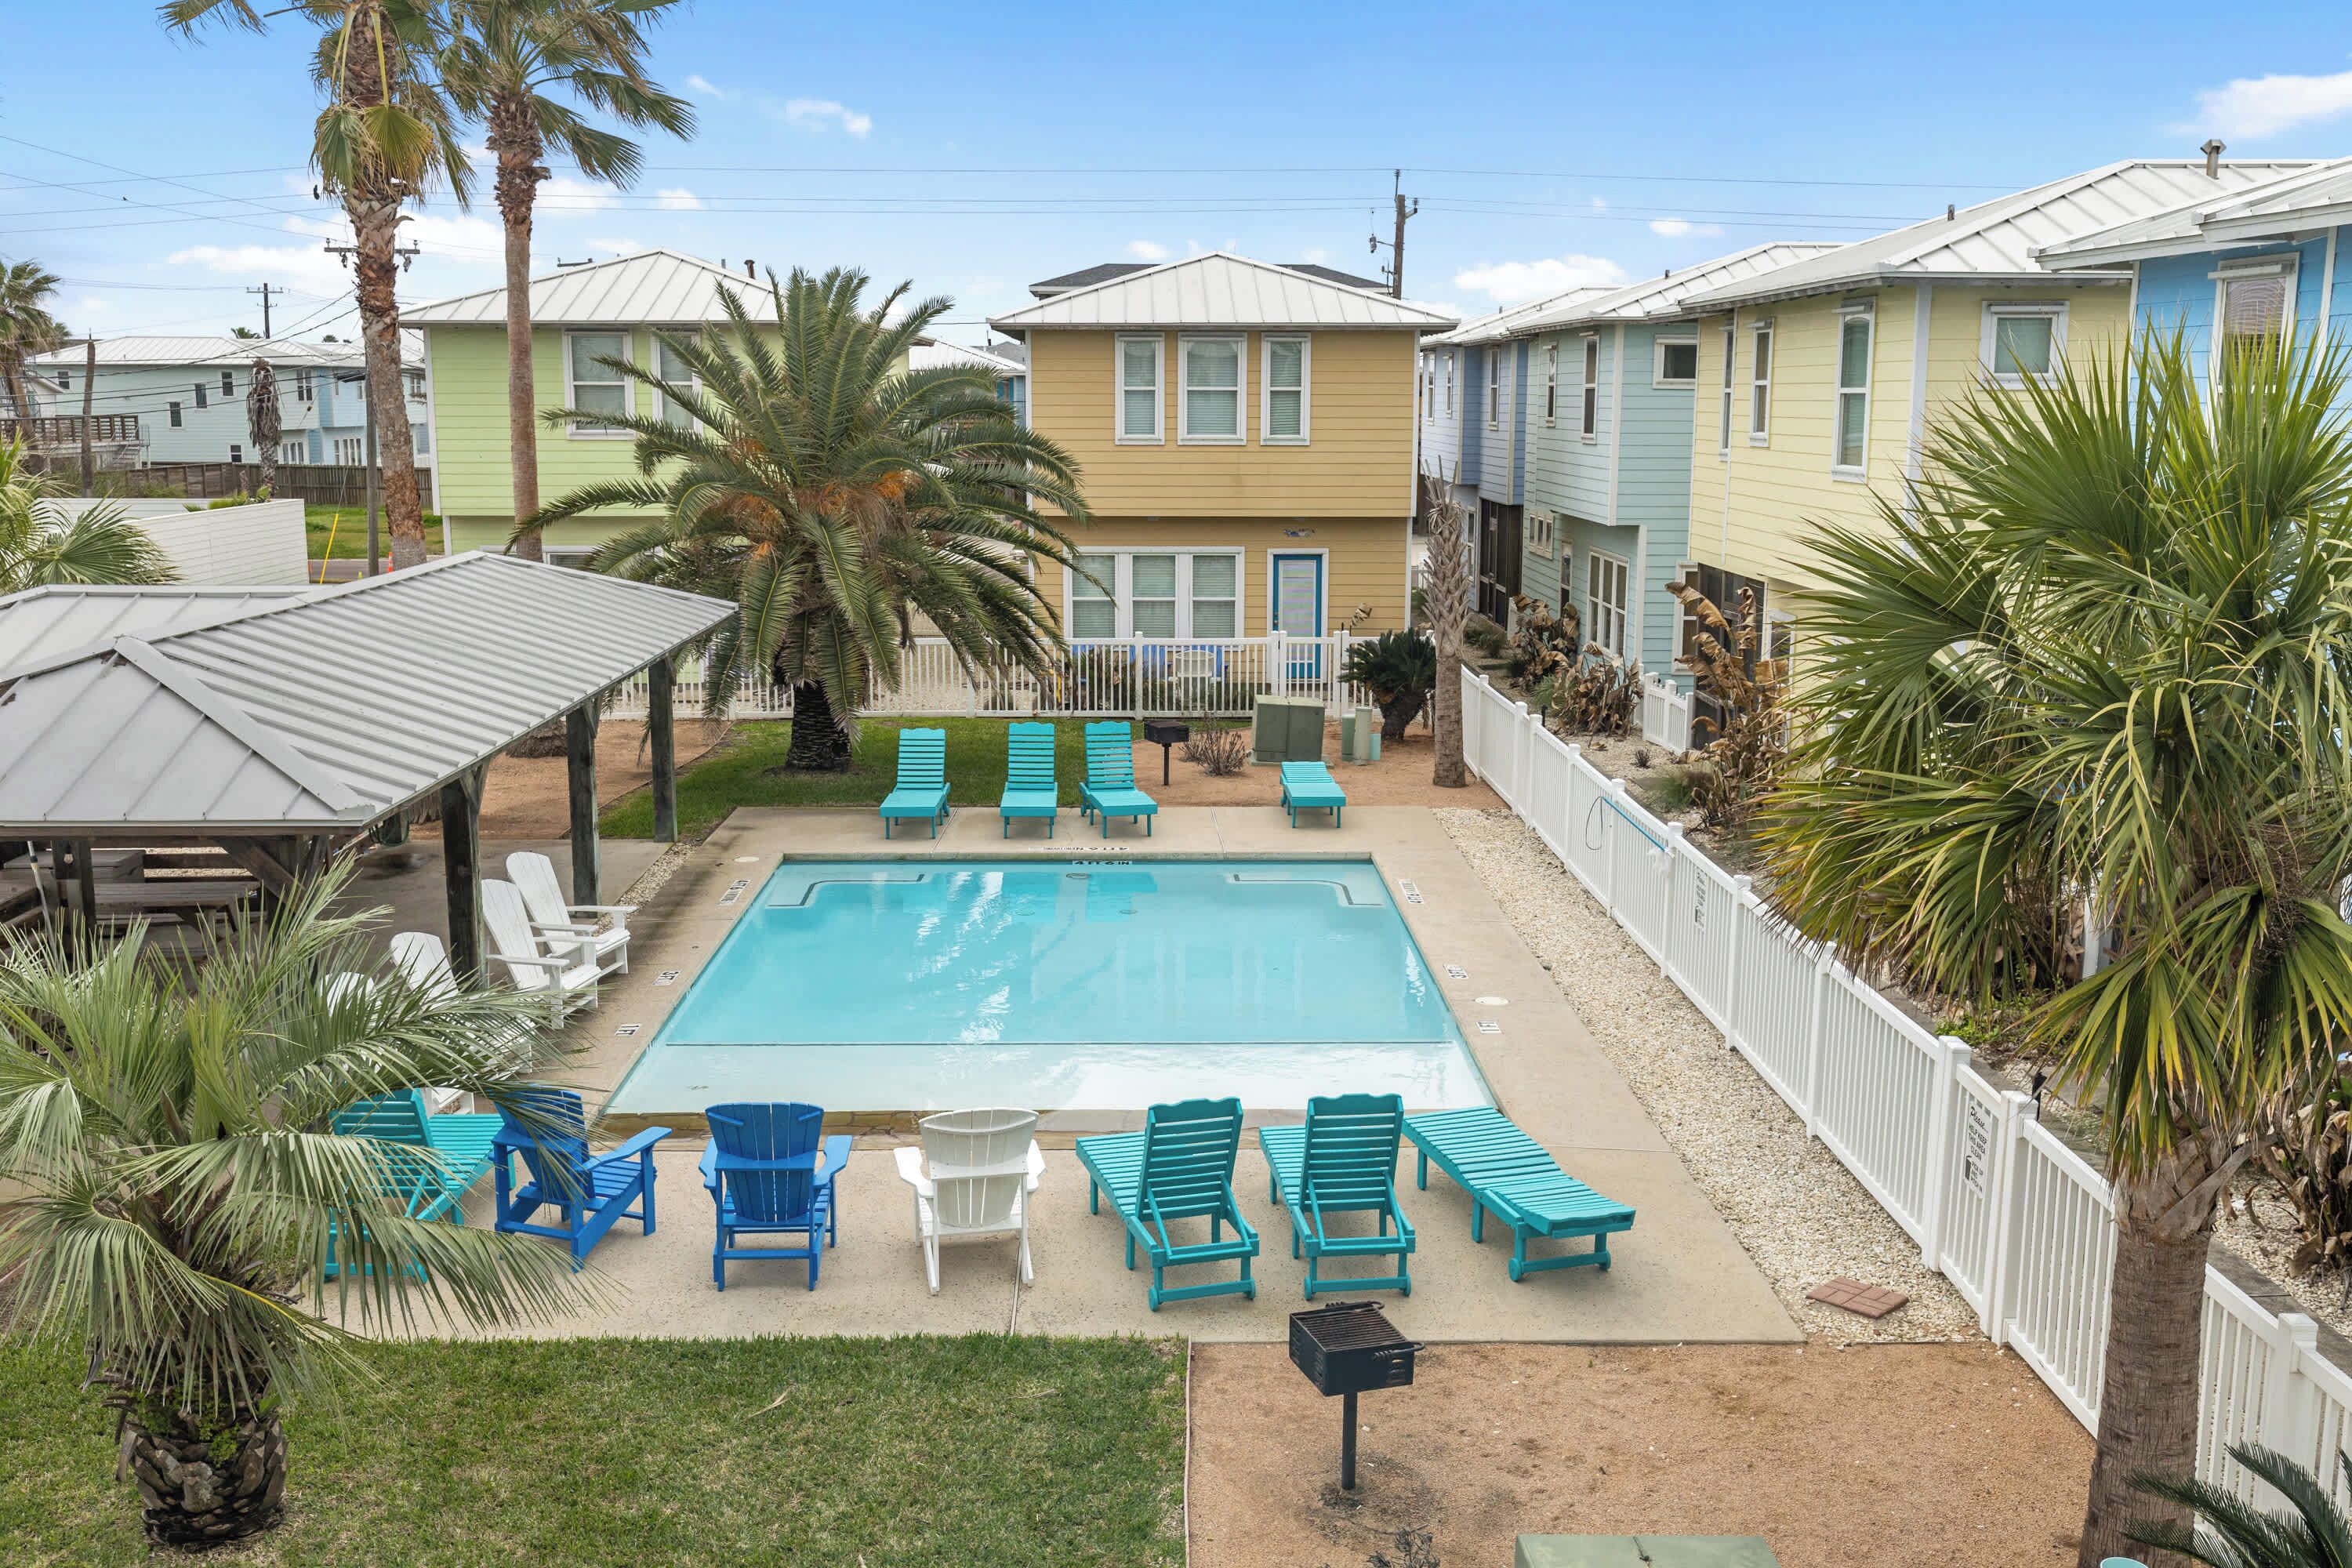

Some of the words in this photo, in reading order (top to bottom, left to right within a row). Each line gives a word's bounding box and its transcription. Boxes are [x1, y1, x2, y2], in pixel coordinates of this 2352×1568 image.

[1969, 1123, 1977, 1135] HELP
[1977, 1132, 1987, 1145] KEEP
[1970, 1145, 1981, 1161] CLEAN
[1976, 1142, 1985, 1154] AREA
